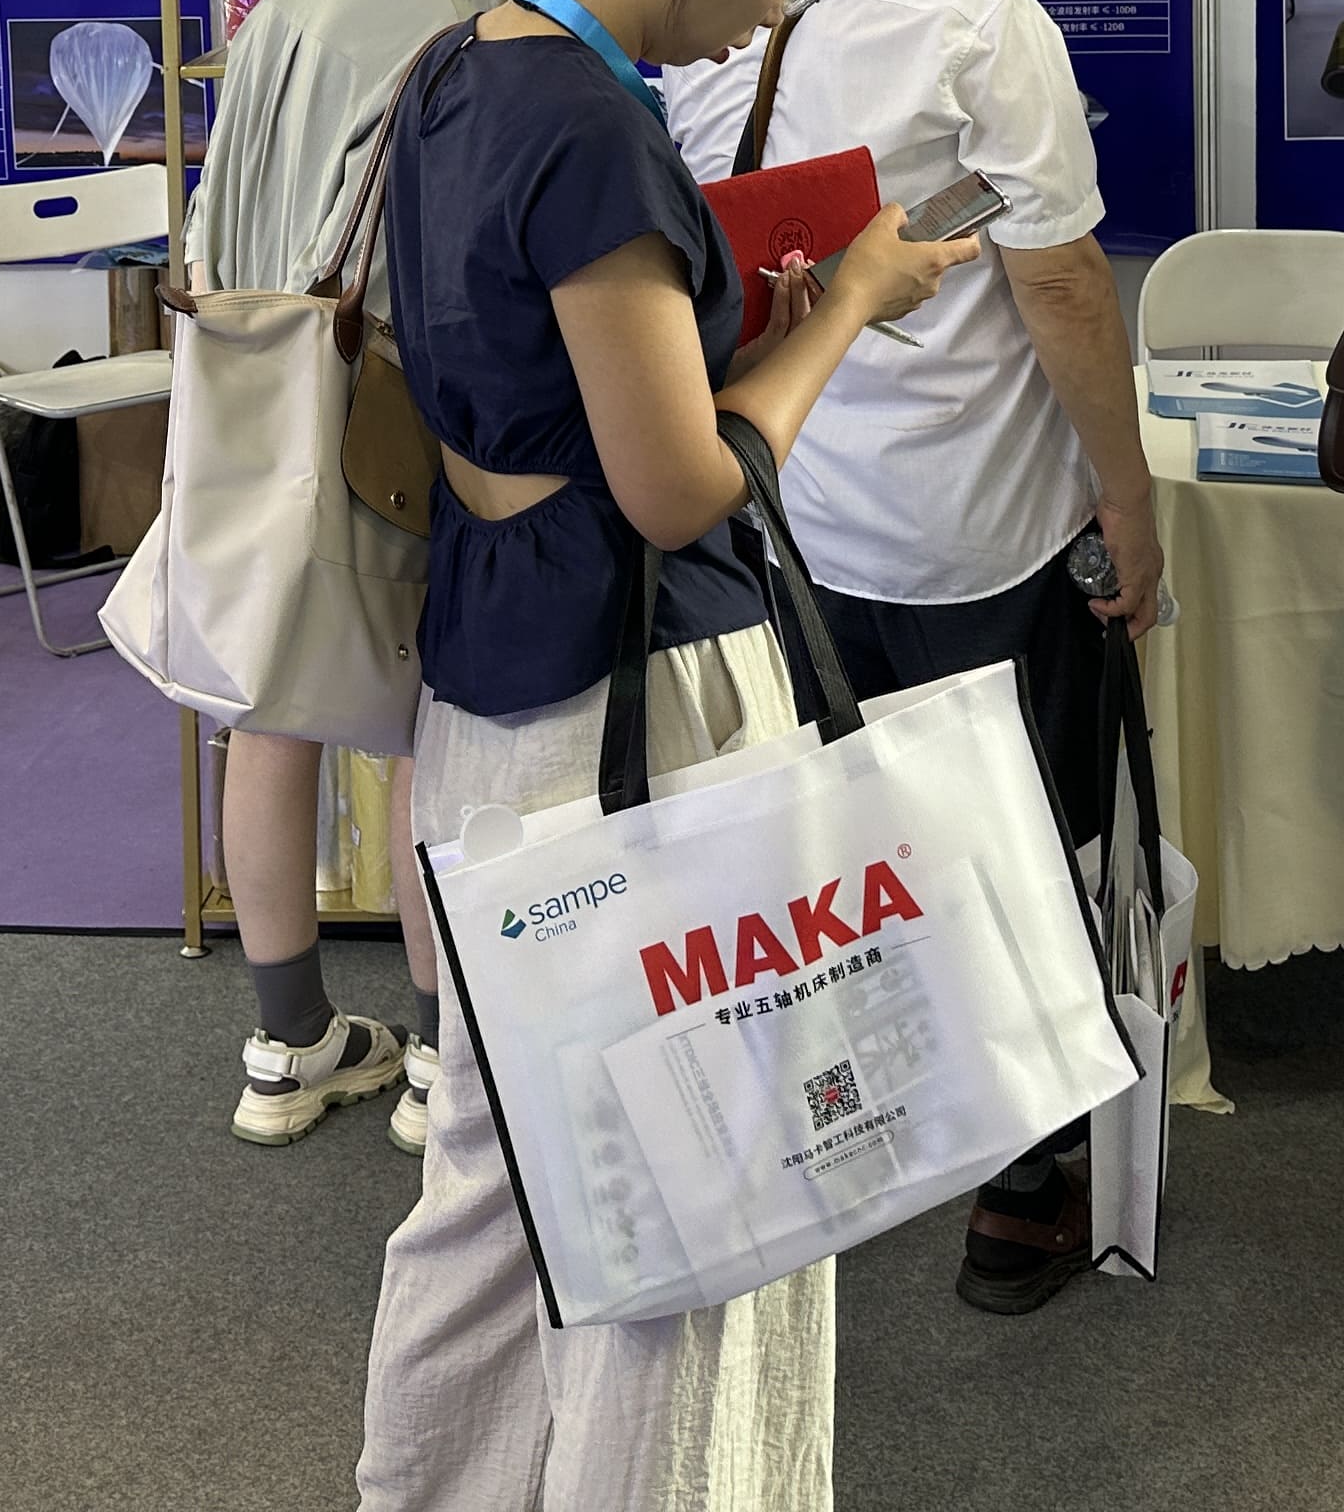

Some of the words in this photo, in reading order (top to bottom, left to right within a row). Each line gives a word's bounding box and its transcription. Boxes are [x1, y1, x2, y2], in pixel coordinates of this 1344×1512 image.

[528, 868, 629, 928] sampe
[535, 917, 578, 943] China
[639, 859, 923, 1018] MAKA
[714, 946, 885, 1028] 专业五轴机床制造商
